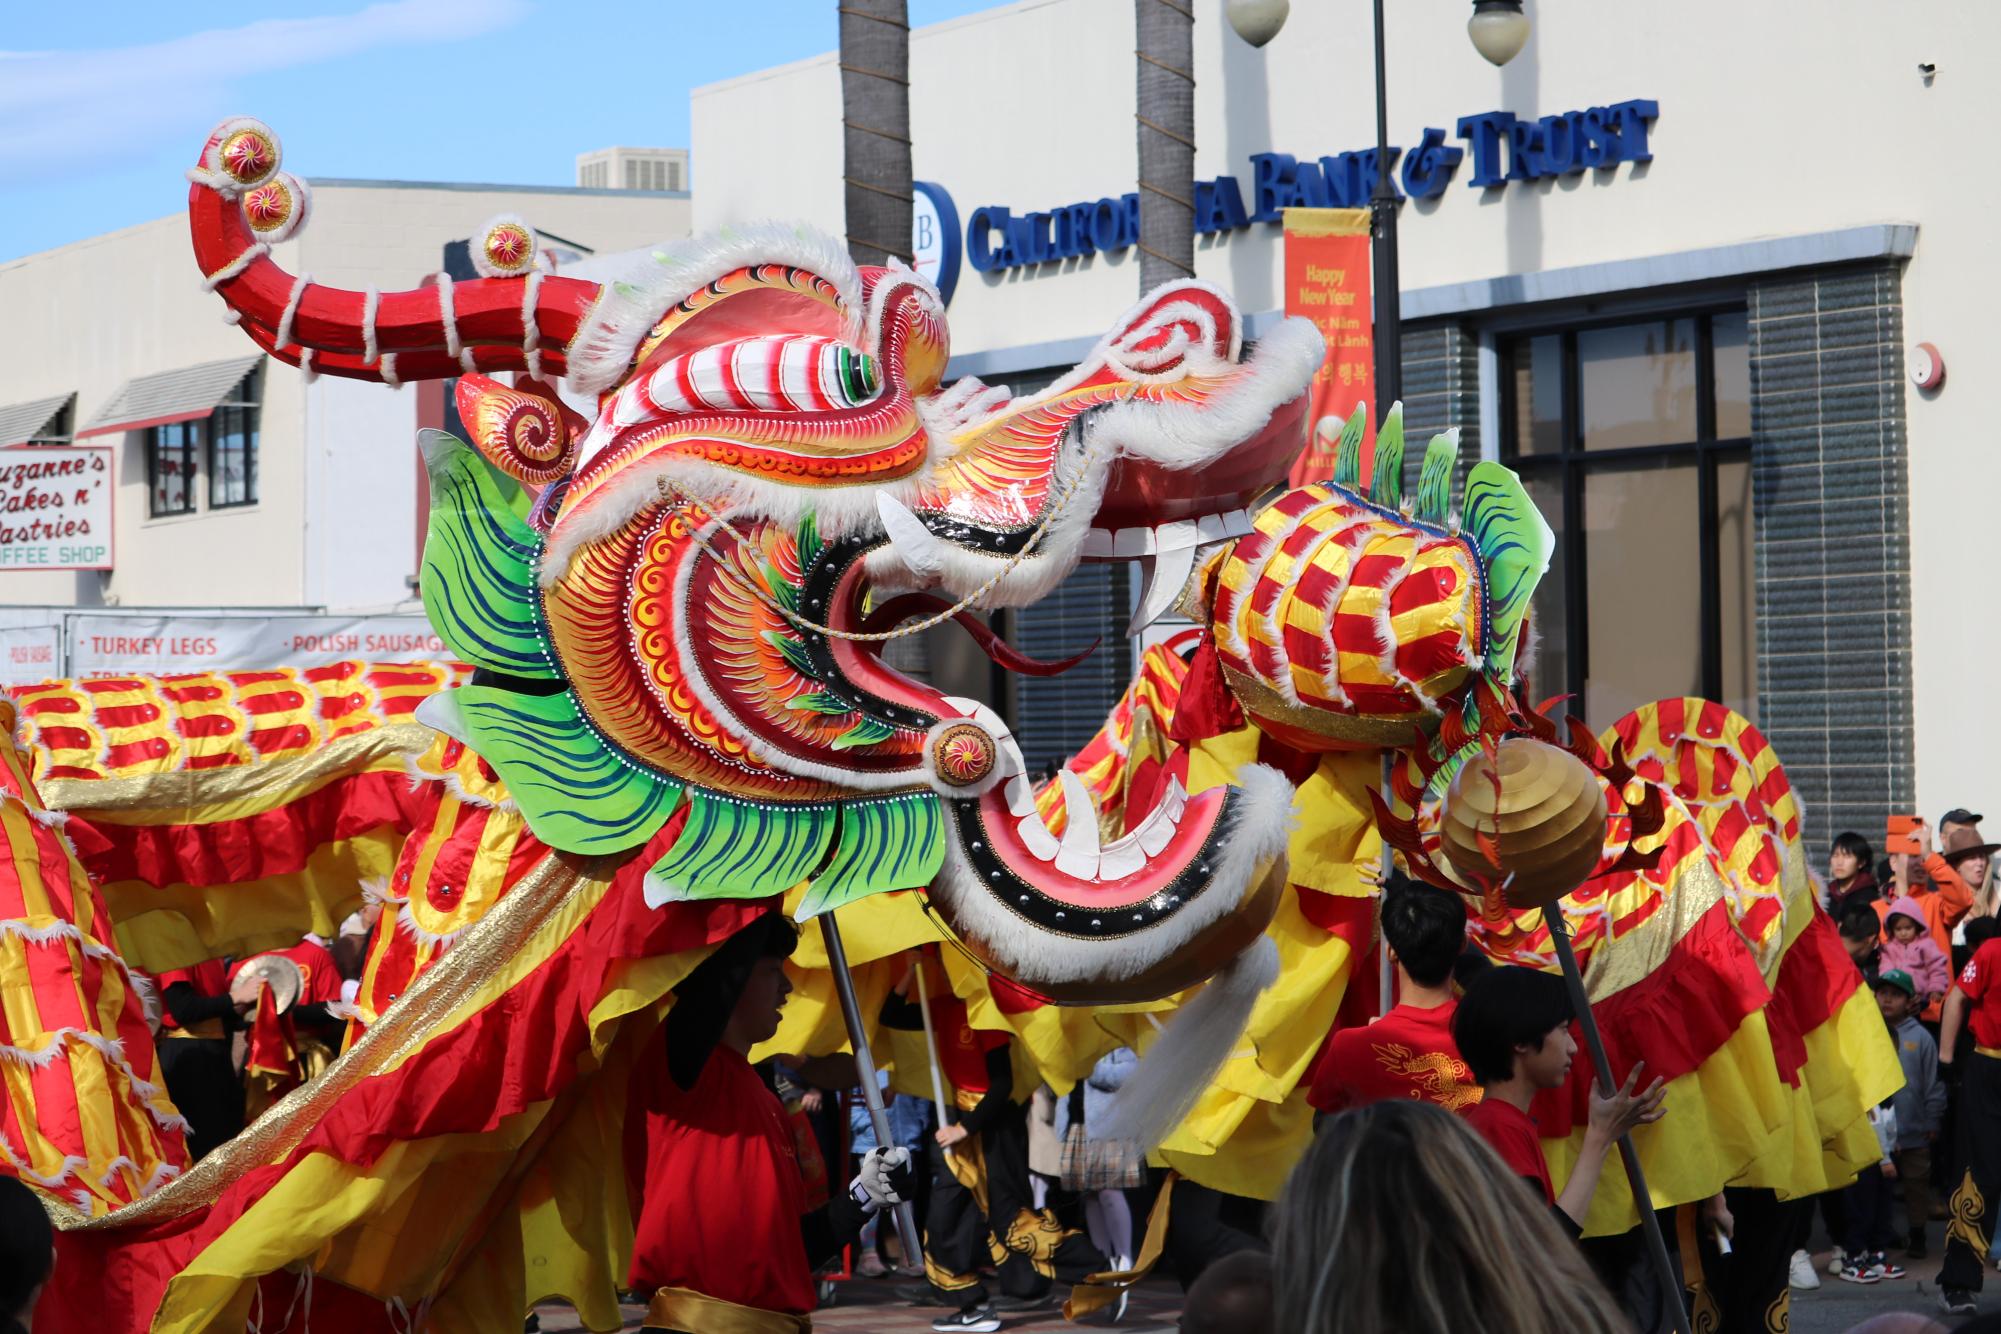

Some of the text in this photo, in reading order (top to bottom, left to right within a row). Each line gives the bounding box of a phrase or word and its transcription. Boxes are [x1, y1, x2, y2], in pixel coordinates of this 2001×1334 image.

[966, 99, 1659, 272] CALIFORA BANK & TRUST
[1306, 264, 1345, 287] Happy
[1299, 287, 1356, 306] New Year
[0, 451, 105, 489] uzanne's
[0, 514, 91, 544] astries
[0, 546, 106, 564] FFEE SHOP
[91, 636, 218, 655] TURKEY LEGS
[292, 635, 359, 652] POLISH
